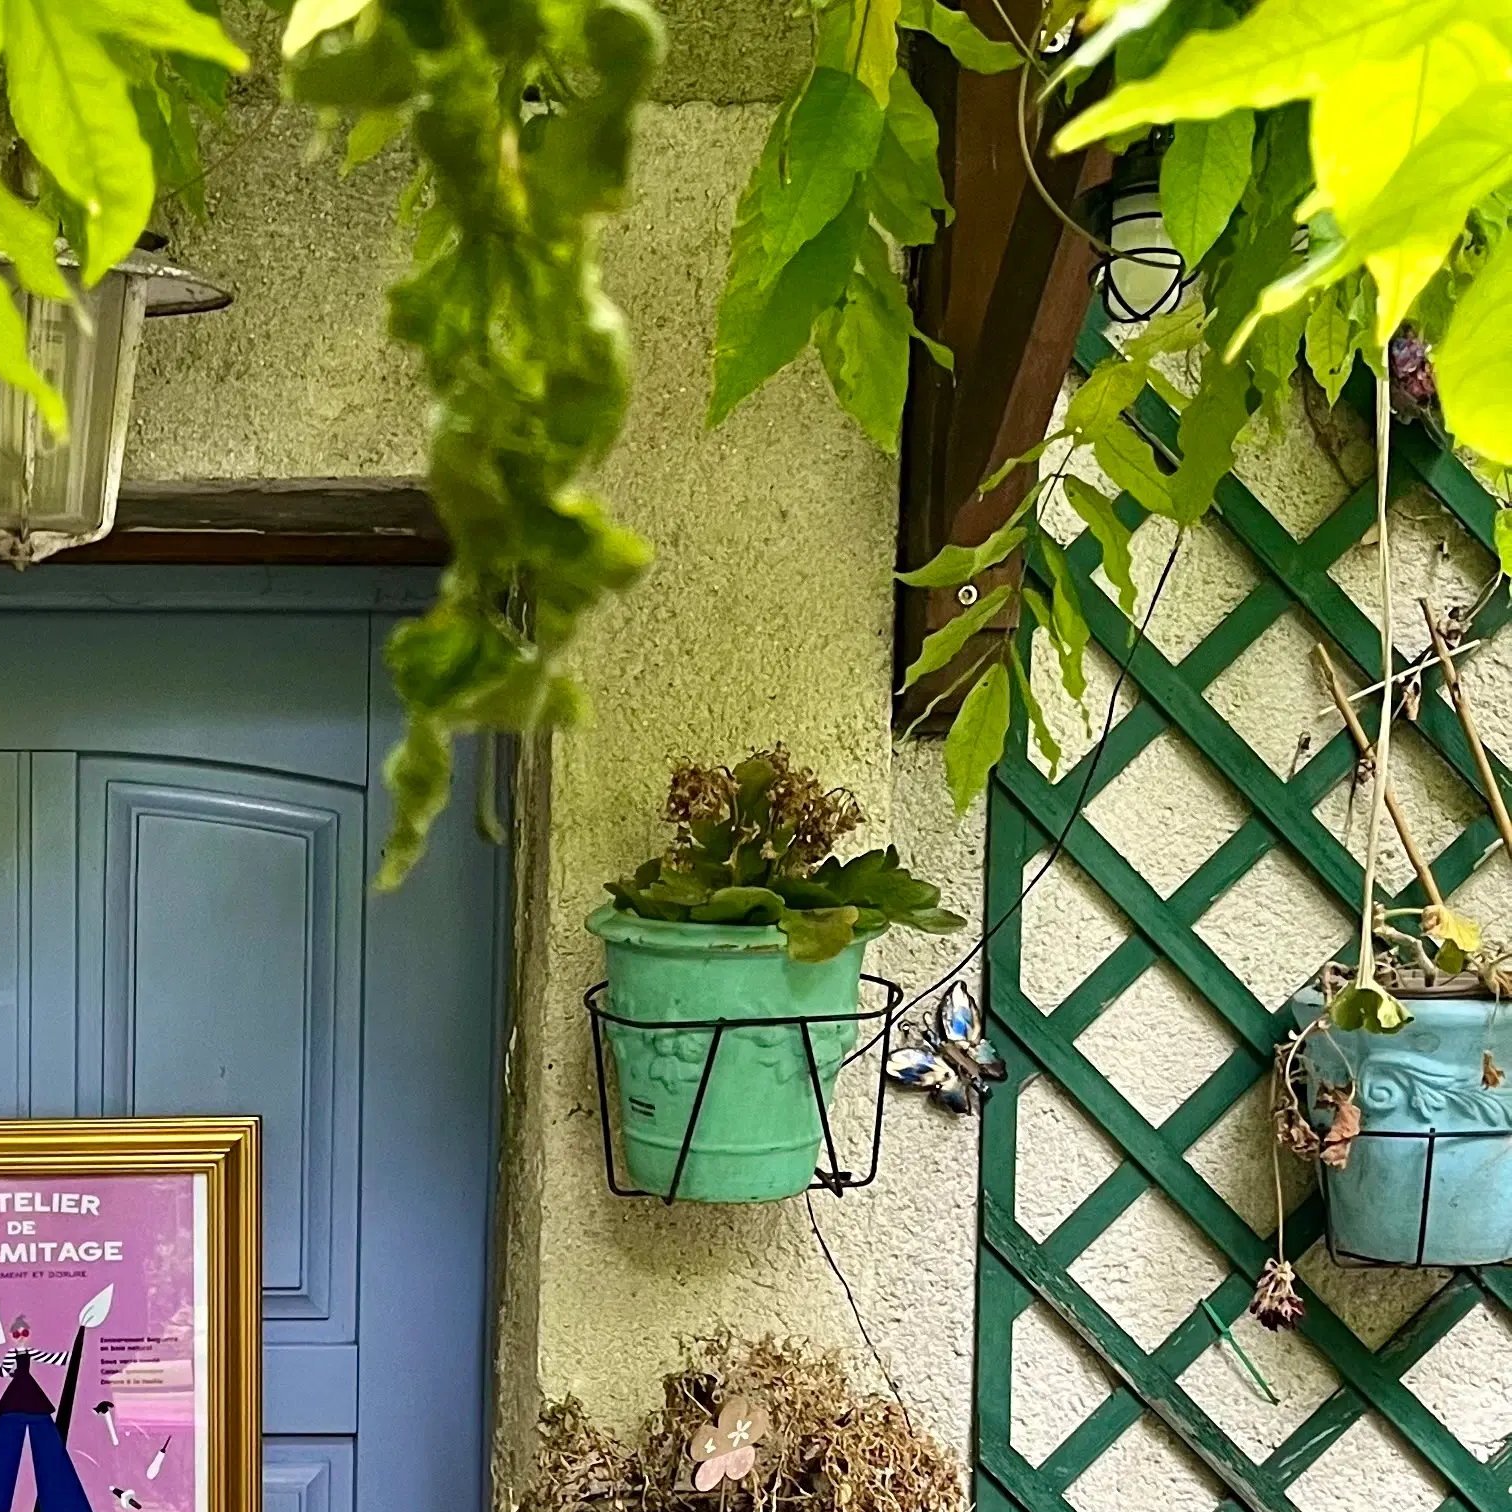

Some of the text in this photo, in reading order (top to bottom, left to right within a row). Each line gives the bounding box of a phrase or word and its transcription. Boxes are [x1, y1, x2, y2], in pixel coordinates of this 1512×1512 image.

[7, 1220, 36, 1235] DE
[32, 1270, 44, 1279] ET
[48, 1270, 88, 1279] DORURE
